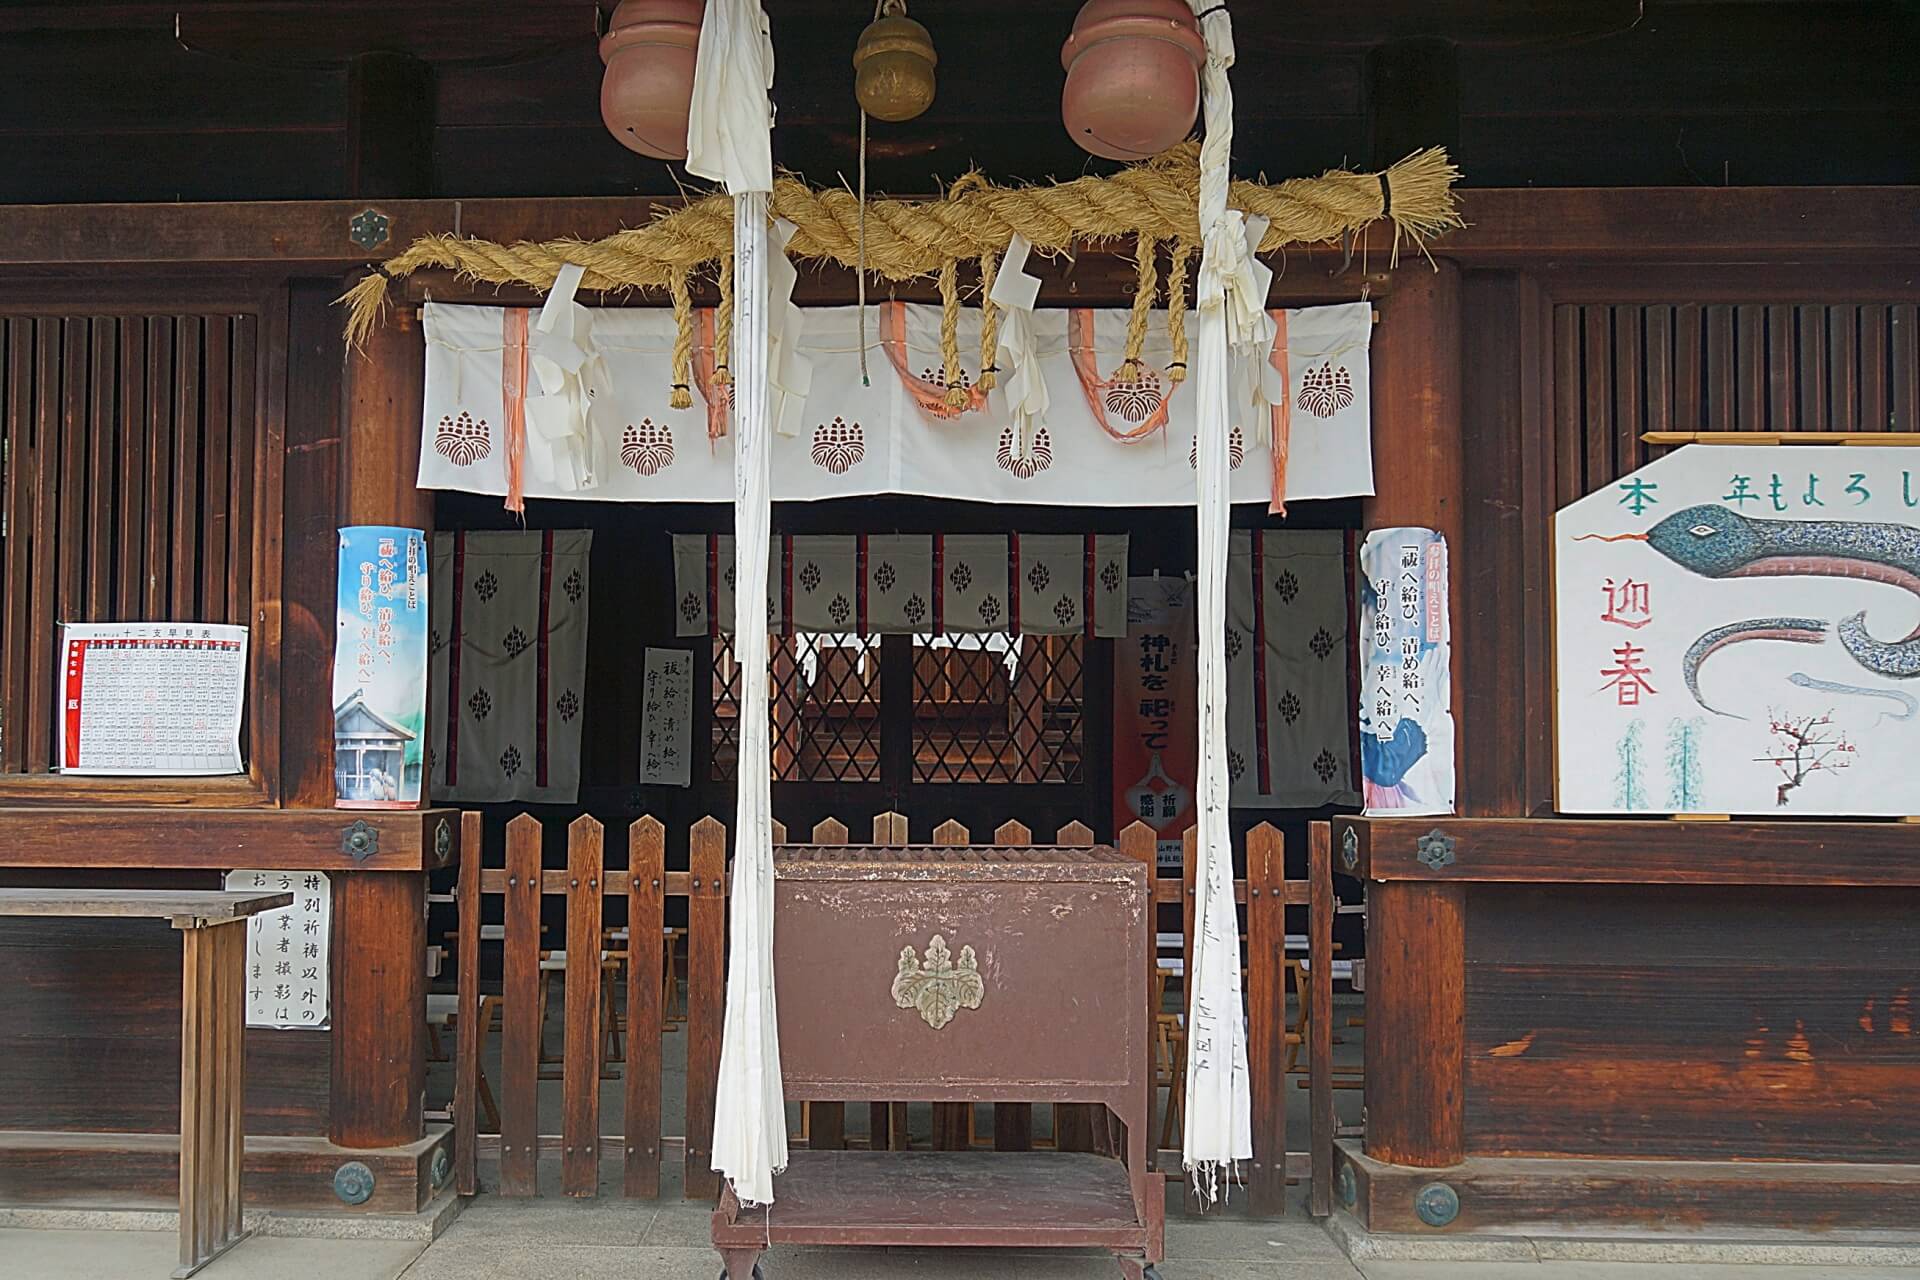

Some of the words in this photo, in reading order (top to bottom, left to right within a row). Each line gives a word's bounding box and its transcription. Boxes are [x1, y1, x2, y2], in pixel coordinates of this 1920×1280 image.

[123, 629, 212, 639] 十二支早見表
[1594, 577, 1658, 705] 迎春
[1140, 794, 1154, 817] 感謝
[1161, 794, 1176, 818] 祈願
[249, 874, 266, 1015] おりします。
[274, 876, 293, 1020] 方業者撮影は
[301, 875, 320, 1021] 特別祈祷以外の
